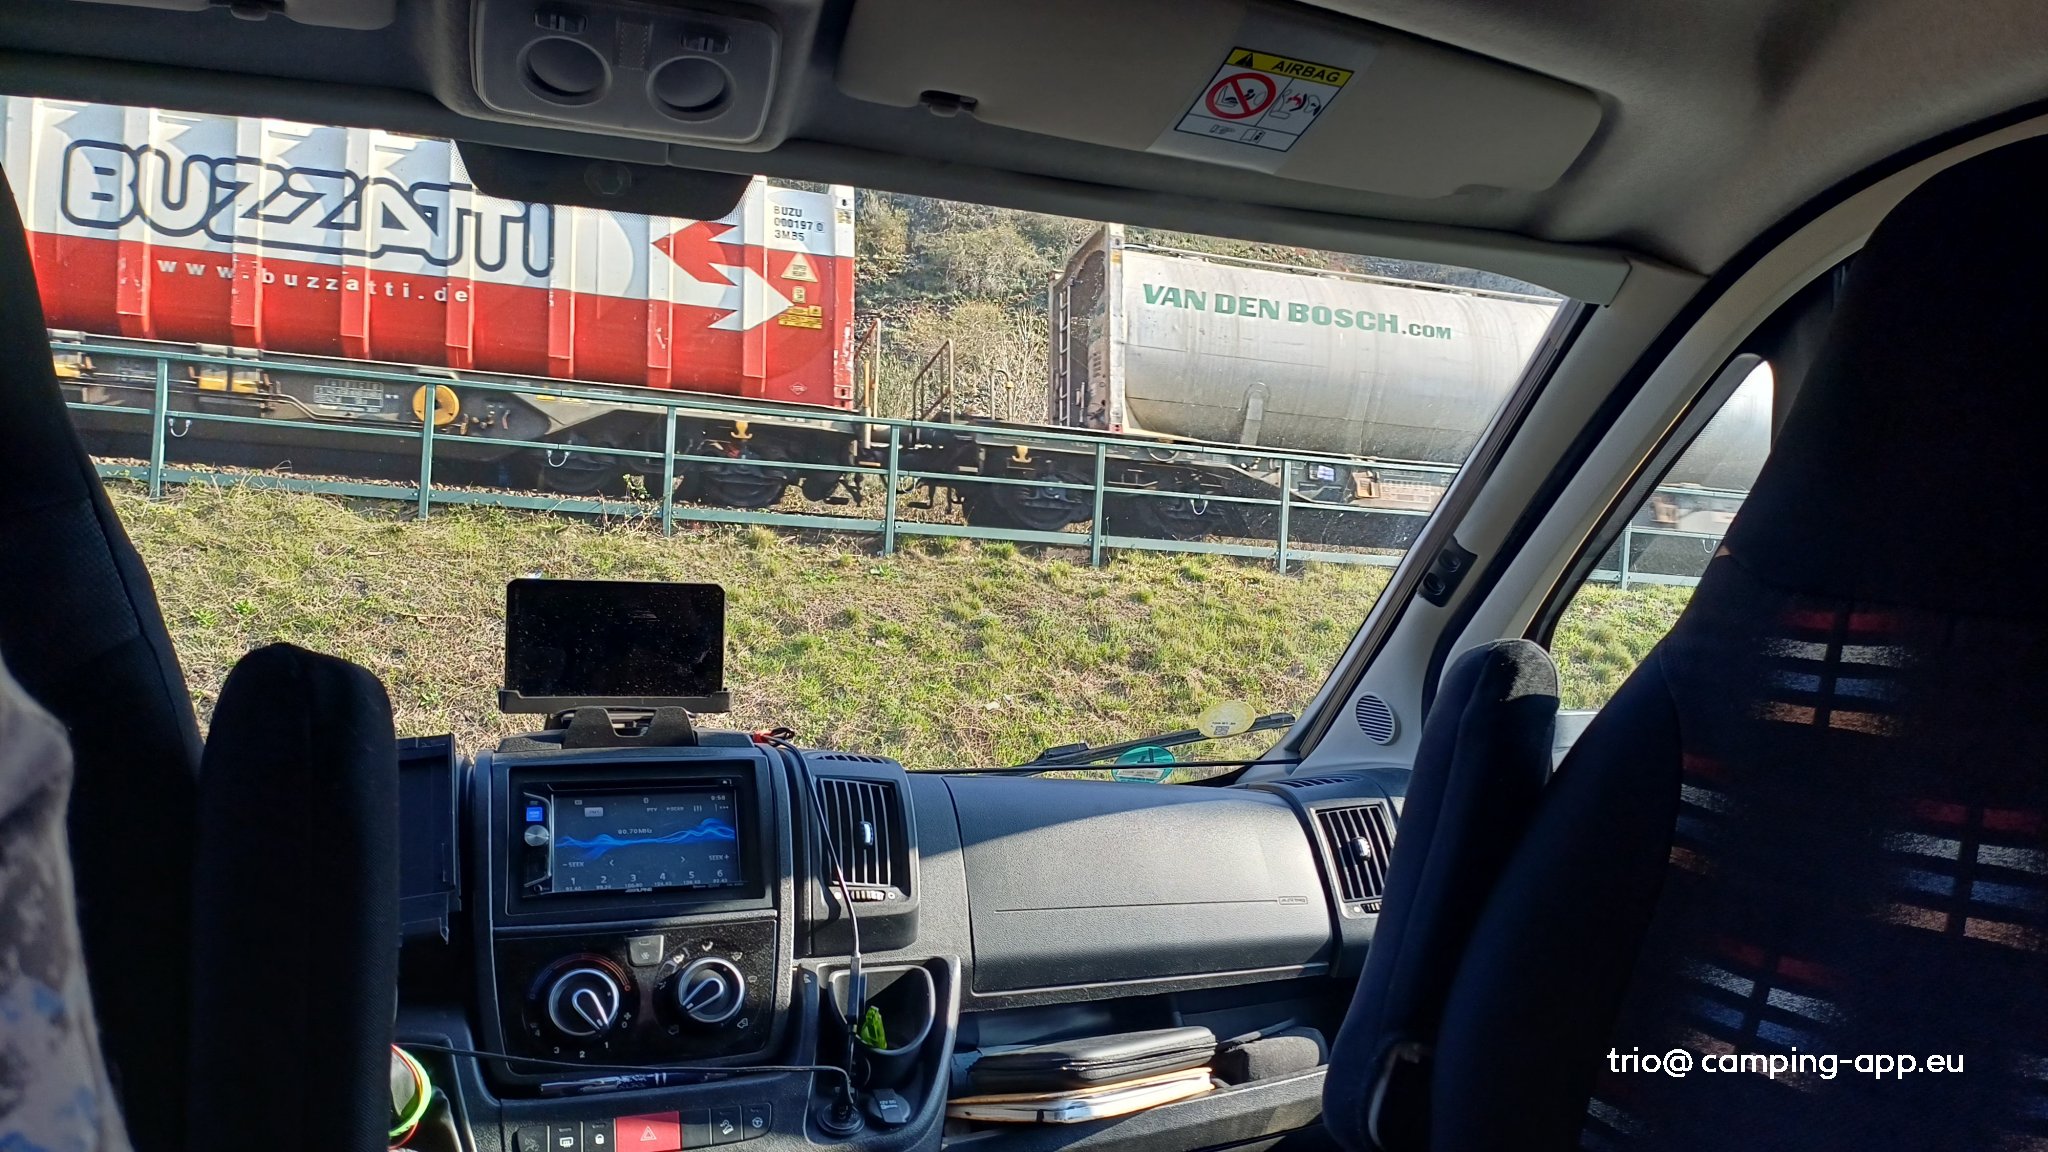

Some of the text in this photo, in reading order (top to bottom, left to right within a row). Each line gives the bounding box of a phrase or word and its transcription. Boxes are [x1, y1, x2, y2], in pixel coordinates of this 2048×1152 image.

[1271, 61, 1341, 83] AIRBAG
[61, 139, 555, 277] BUZZATTI
[774, 205, 803, 218] BUZU
[774, 217, 814, 231] 000197
[157, 258, 470, 303] www.buzzatti.de
[1142, 283, 1207, 311] VAN
[1214, 293, 1281, 321] DEN
[630, 874, 637, 882] 3
[659, 872, 667, 880] 4
[688, 870, 695, 879] 5
[716, 869, 723, 877] 6
[570, 877, 576, 885] 1
[600, 875, 607, 884] 2
